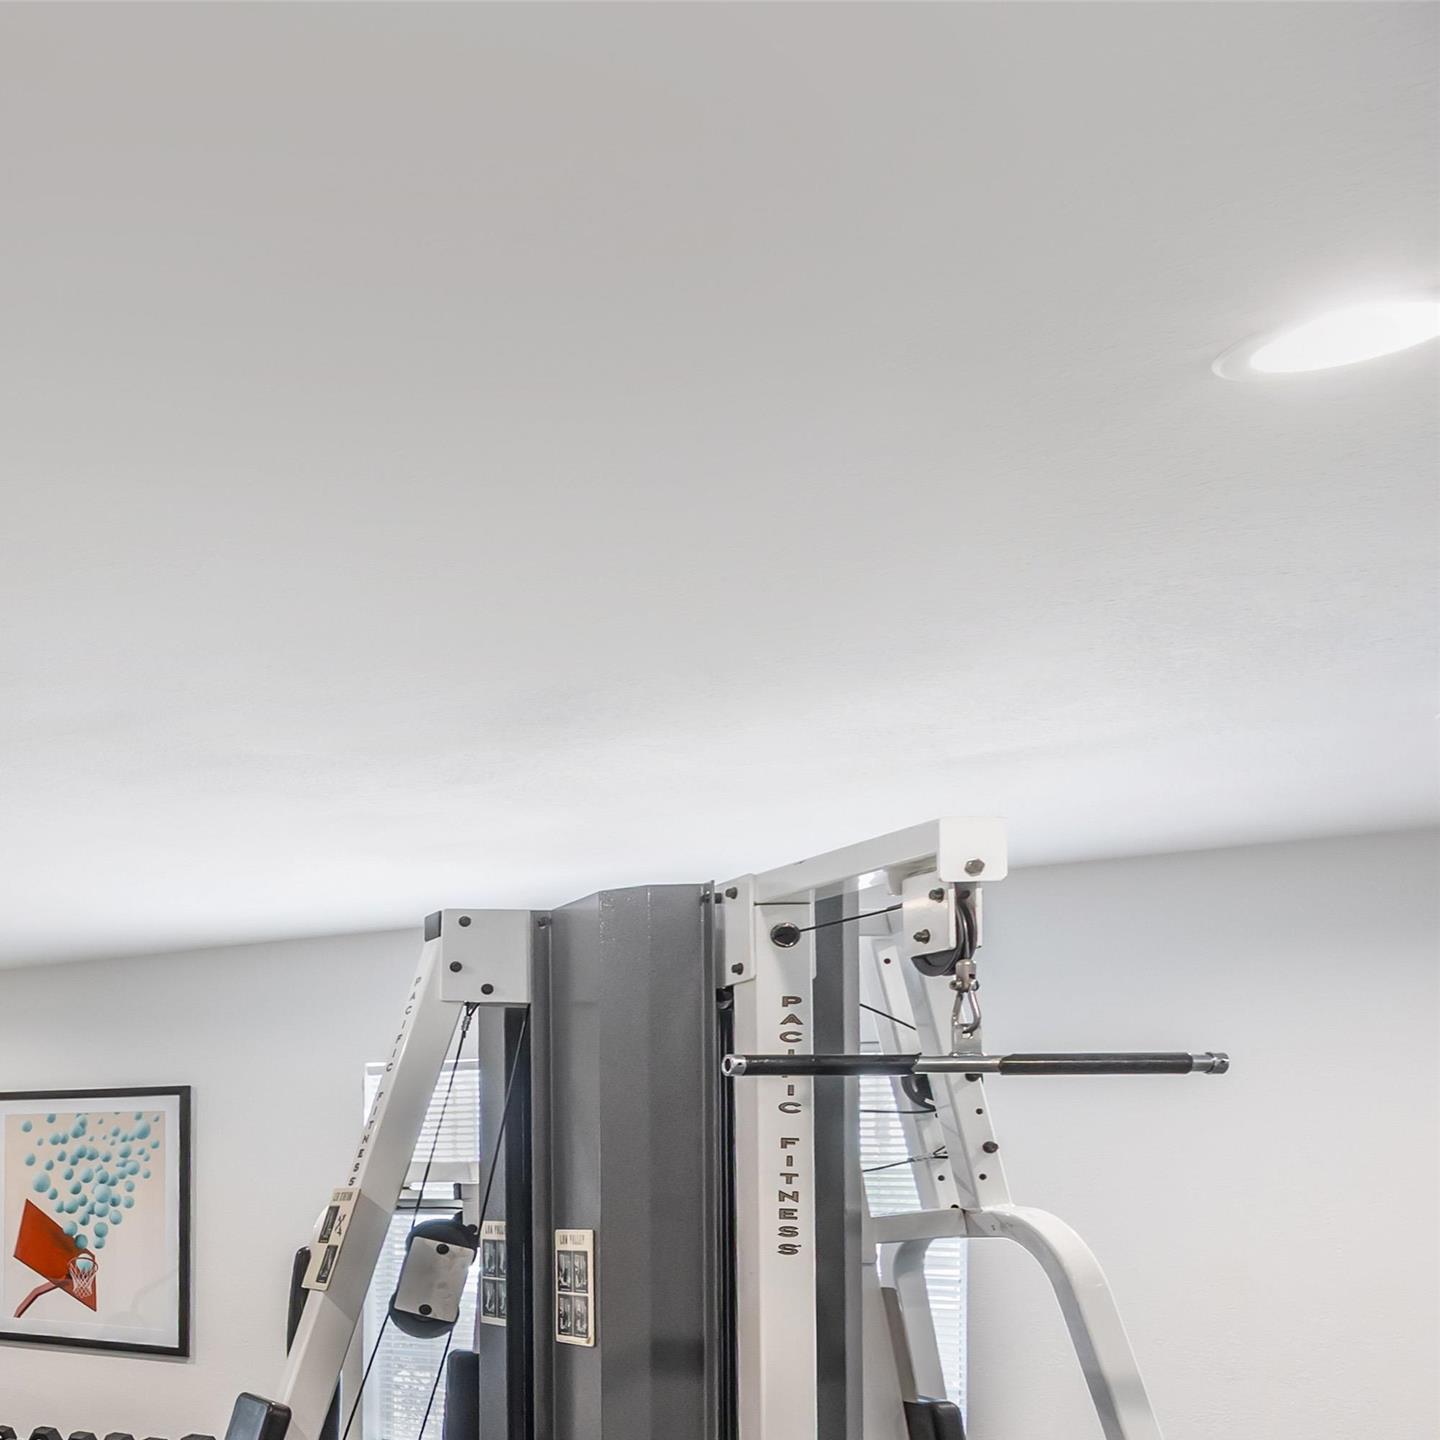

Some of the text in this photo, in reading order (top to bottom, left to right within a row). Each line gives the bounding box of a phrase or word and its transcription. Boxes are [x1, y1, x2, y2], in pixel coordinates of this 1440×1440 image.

[348, 976, 422, 1186] PACIFIC FITNESS
[777, 995, 804, 1256] PACIIC FITNESS
